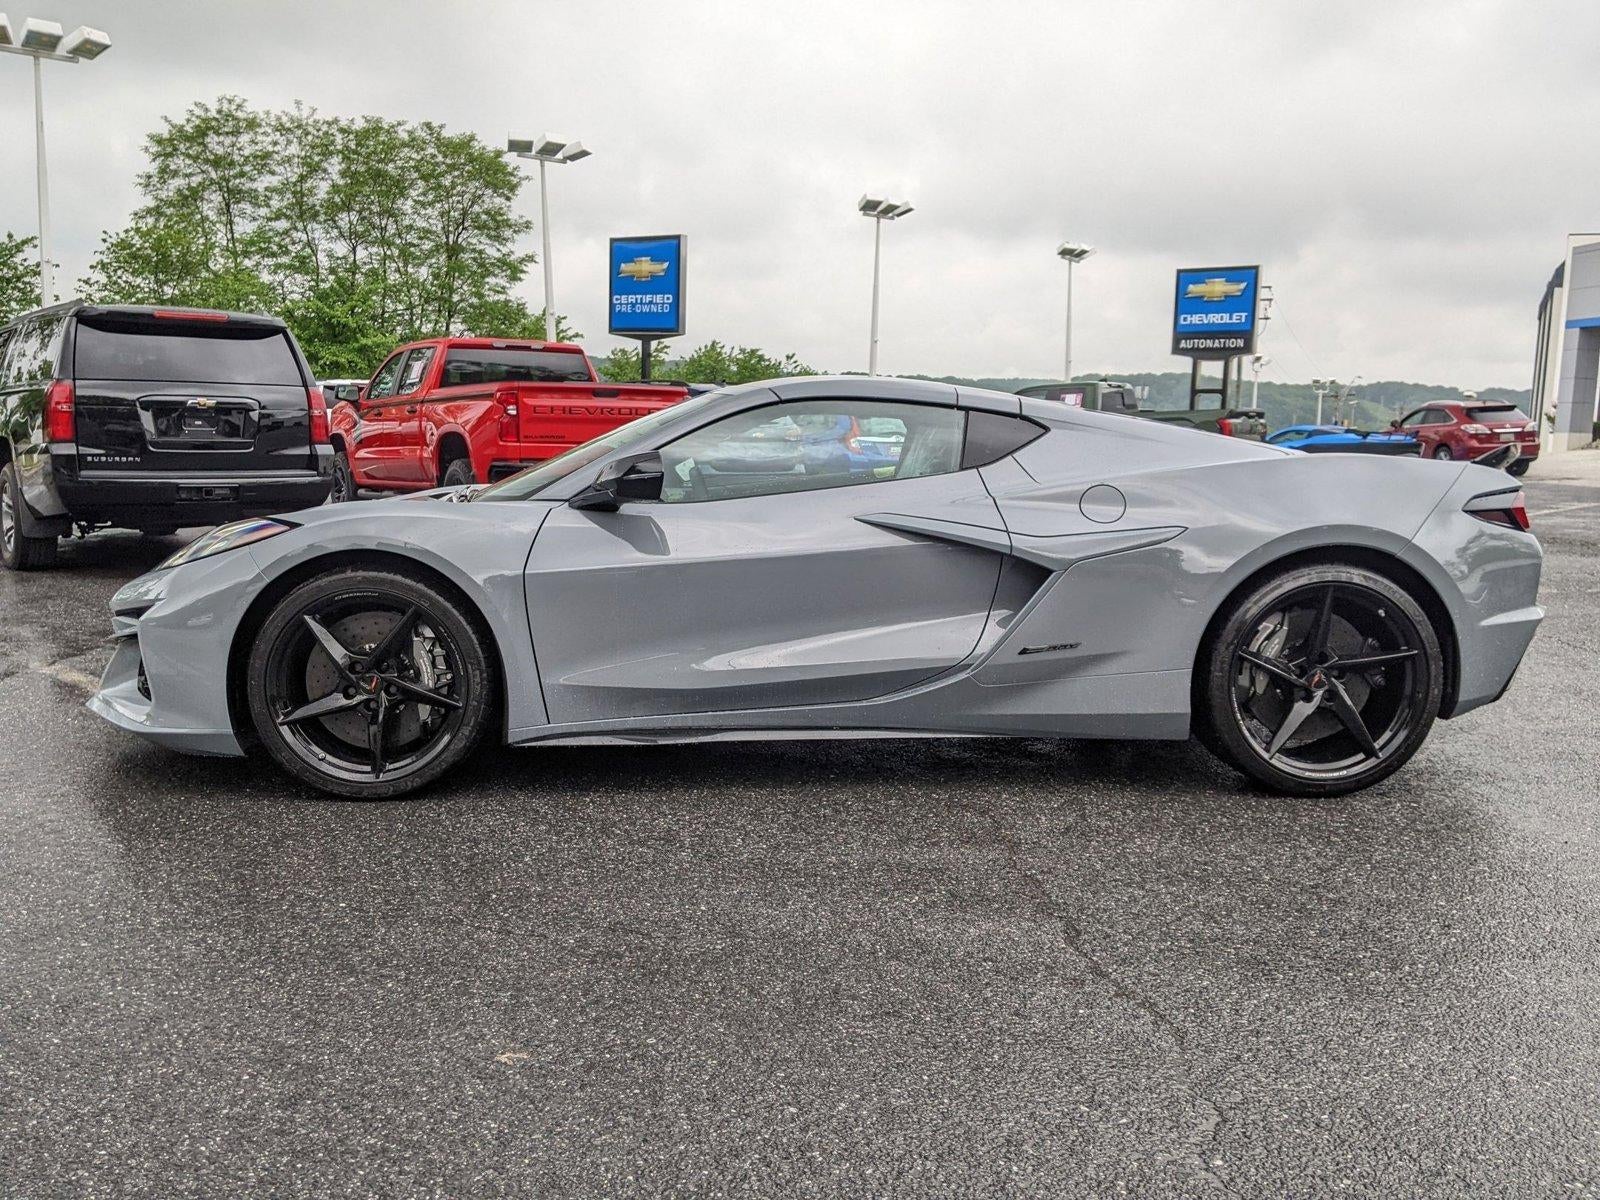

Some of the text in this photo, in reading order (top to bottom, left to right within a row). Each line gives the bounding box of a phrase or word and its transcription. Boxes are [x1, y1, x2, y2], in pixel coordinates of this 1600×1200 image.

[613, 294, 673, 304] CERTIFIED
[615, 304, 670, 313] PRE-OWNED
[1180, 312, 1248, 325] CHEVROLET
[1179, 338, 1245, 349] AUTONATION
